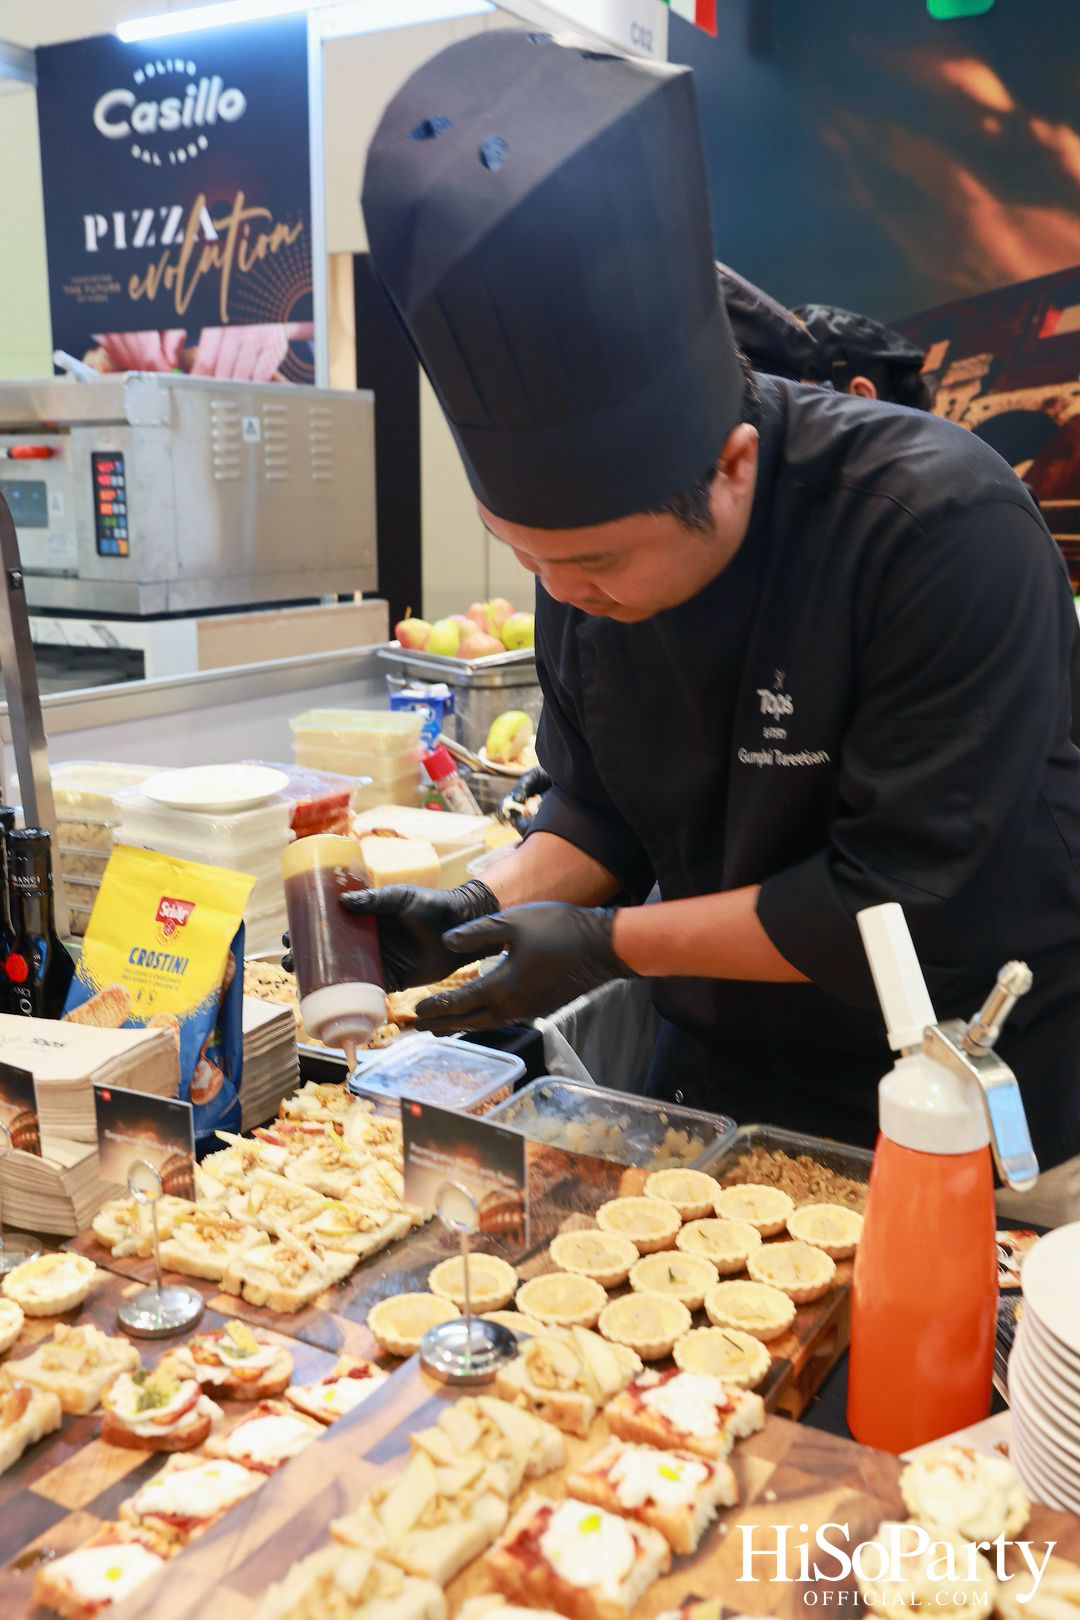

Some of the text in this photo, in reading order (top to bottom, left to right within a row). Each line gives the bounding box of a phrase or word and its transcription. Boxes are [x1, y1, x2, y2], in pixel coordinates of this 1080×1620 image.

[133, 58, 197, 86] MOLINO
[93, 75, 247, 139] Casillo
[83, 205, 219, 252] PIZZA
[128, 190, 304, 324] evolution
[756, 688, 794, 722] Tops
[128, 946, 190, 976] CROSTINI
